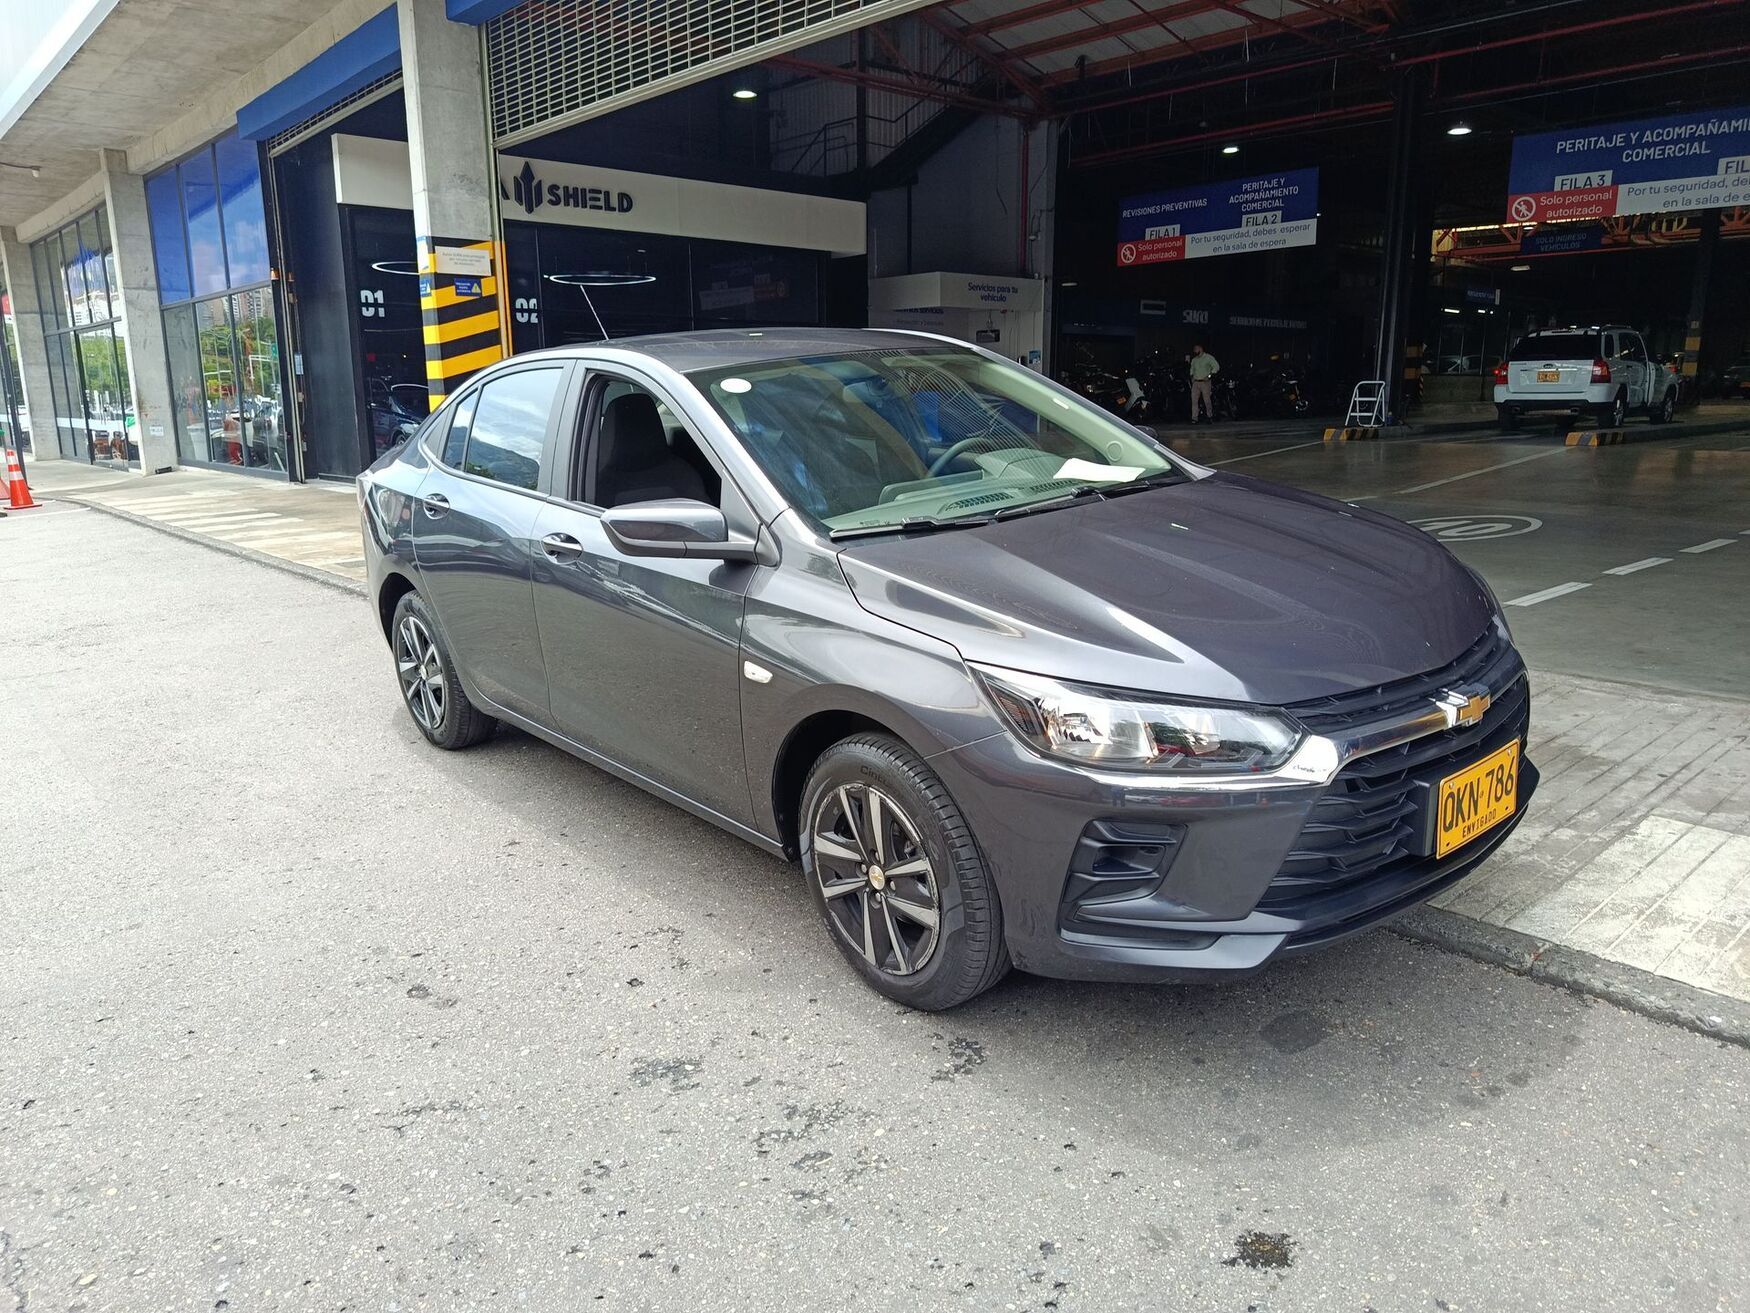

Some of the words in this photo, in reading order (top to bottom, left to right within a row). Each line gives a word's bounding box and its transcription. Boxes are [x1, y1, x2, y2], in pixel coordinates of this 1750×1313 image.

[1556, 134, 1626, 153] PERITAJE
[1630, 132, 1639, 144] Y
[1622, 141, 1711, 162] COMERCIAL
[1242, 179, 1278, 192] PERITAJE
[1280, 177, 1286, 186] Y
[1560, 176, 1592, 190] FILA
[1597, 174, 1606, 186] 3
[1627, 187, 1646, 196] Por
[1649, 186, 1660, 195] tu
[1663, 178, 1728, 194] seguridad,
[547, 184, 633, 213] SHIELD
[1228, 185, 1299, 204] ACOMPAÑAMIENTO
[1540, 196, 1563, 206] Solo
[1565, 190, 1612, 205] personal
[1663, 199, 1678, 208] en
[1681, 197, 1691, 207] la
[1695, 194, 1719, 206] sala
[1722, 192, 1739, 203] de
[1122, 205, 1161, 218] REVISIONES
[1161, 198, 1208, 212] PREVENTIVAS
[1241, 199, 1284, 212] COMERCIAL
[1546, 205, 1602, 218] autorizado
[1245, 215, 1268, 227] FILA
[1271, 214, 1278, 224] 2
[1149, 228, 1170, 239] FILA
[1172, 227, 1176, 236] 1
[1190, 236, 1203, 245] Por
[1212, 230, 1252, 243] seguridad,
[1252, 227, 1277, 237] debes
[1280, 223, 1311, 234] esperar
[1138, 242, 1153, 251] Solo
[1153, 239, 1182, 250] personal
[1224, 243, 1231, 252] la
[1231, 242, 1247, 251] sala
[1248, 240, 1258, 249] de
[1259, 239, 1286, 250] espera
[1142, 250, 1177, 261] autorizado
[968, 282, 995, 292] Servicios
[1462, 808, 1497, 838] ENVIGADO
